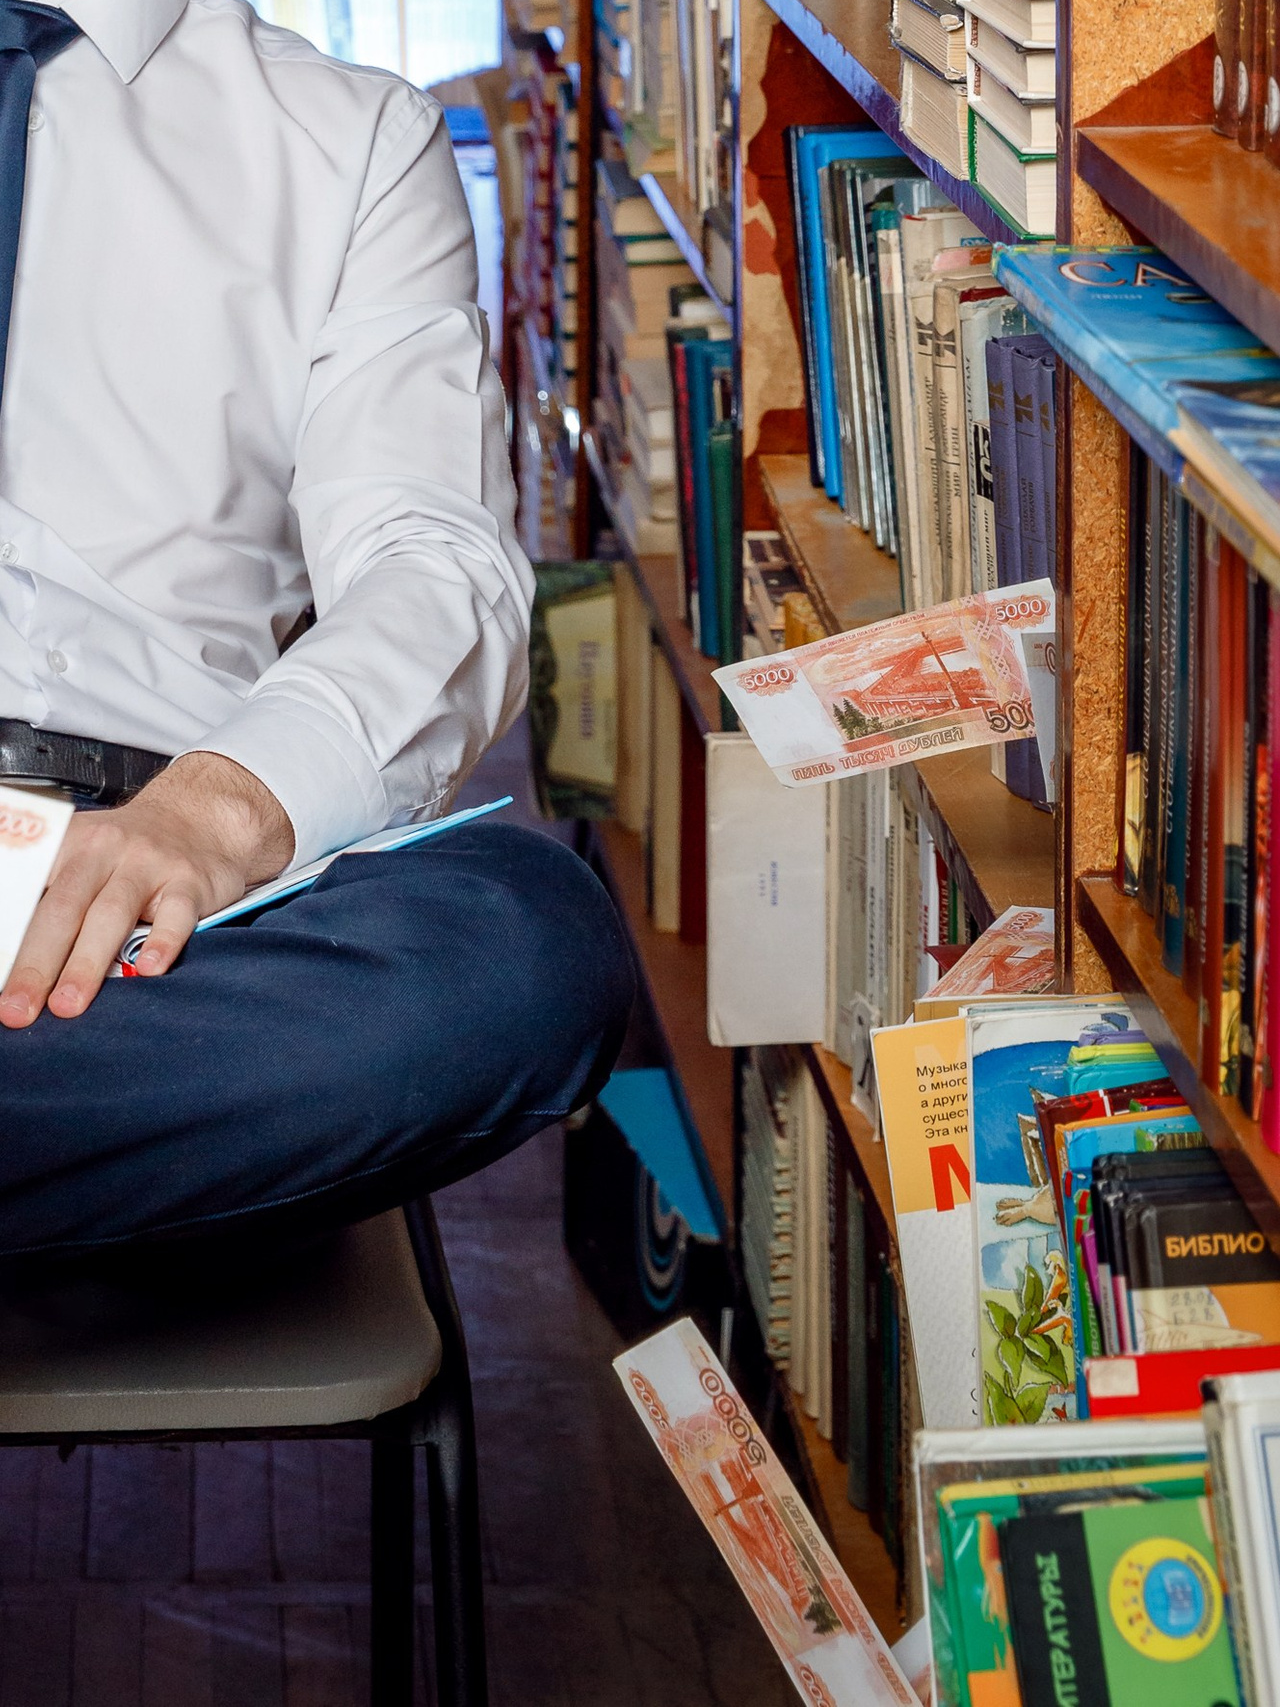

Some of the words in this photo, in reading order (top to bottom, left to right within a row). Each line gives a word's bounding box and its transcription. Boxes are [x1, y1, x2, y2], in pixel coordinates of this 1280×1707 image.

[1058, 259, 1205, 288] СА
[951, 425, 960, 458] ГРИН
[953, 472, 961, 499] МИР
[1119, 507, 1128, 596] РОССИИ
[1144, 523, 1152, 650] АДМИРАЛОВ
[1161, 498, 1169, 661] АРХИТЕКТОРОВ
[892, 613, 926, 628] СРЕДСТВОМ
[994, 597, 1043, 622] 5000
[742, 666, 793, 690] 5000
[1117, 603, 1127, 733] КРАСАВИЦЫ
[984, 698, 1037, 733] 500
[1143, 657, 1151, 751] ВЕЛИКИХ
[791, 761, 836, 781] ПЯТЬ
[838, 746, 896, 770] ТЫСЯЧ
[898, 725, 966, 757] ДУБЛЕЙ
[1142, 756, 1150, 799] СТО
[1166, 787, 1174, 834] СТО
[1010, 910, 1033, 935] 5000
[915, 1060, 968, 1078] Музыка
[918, 1083, 927, 1093] о
[920, 1099, 928, 1109] а
[924, 1126, 951, 1139] Эта
[953, 1124, 968, 1135] кн
[1165, 1230, 1265, 1259] БИБЛИО
[632, 1374, 670, 1431] 5000
[698, 1366, 767, 1467] 5000
